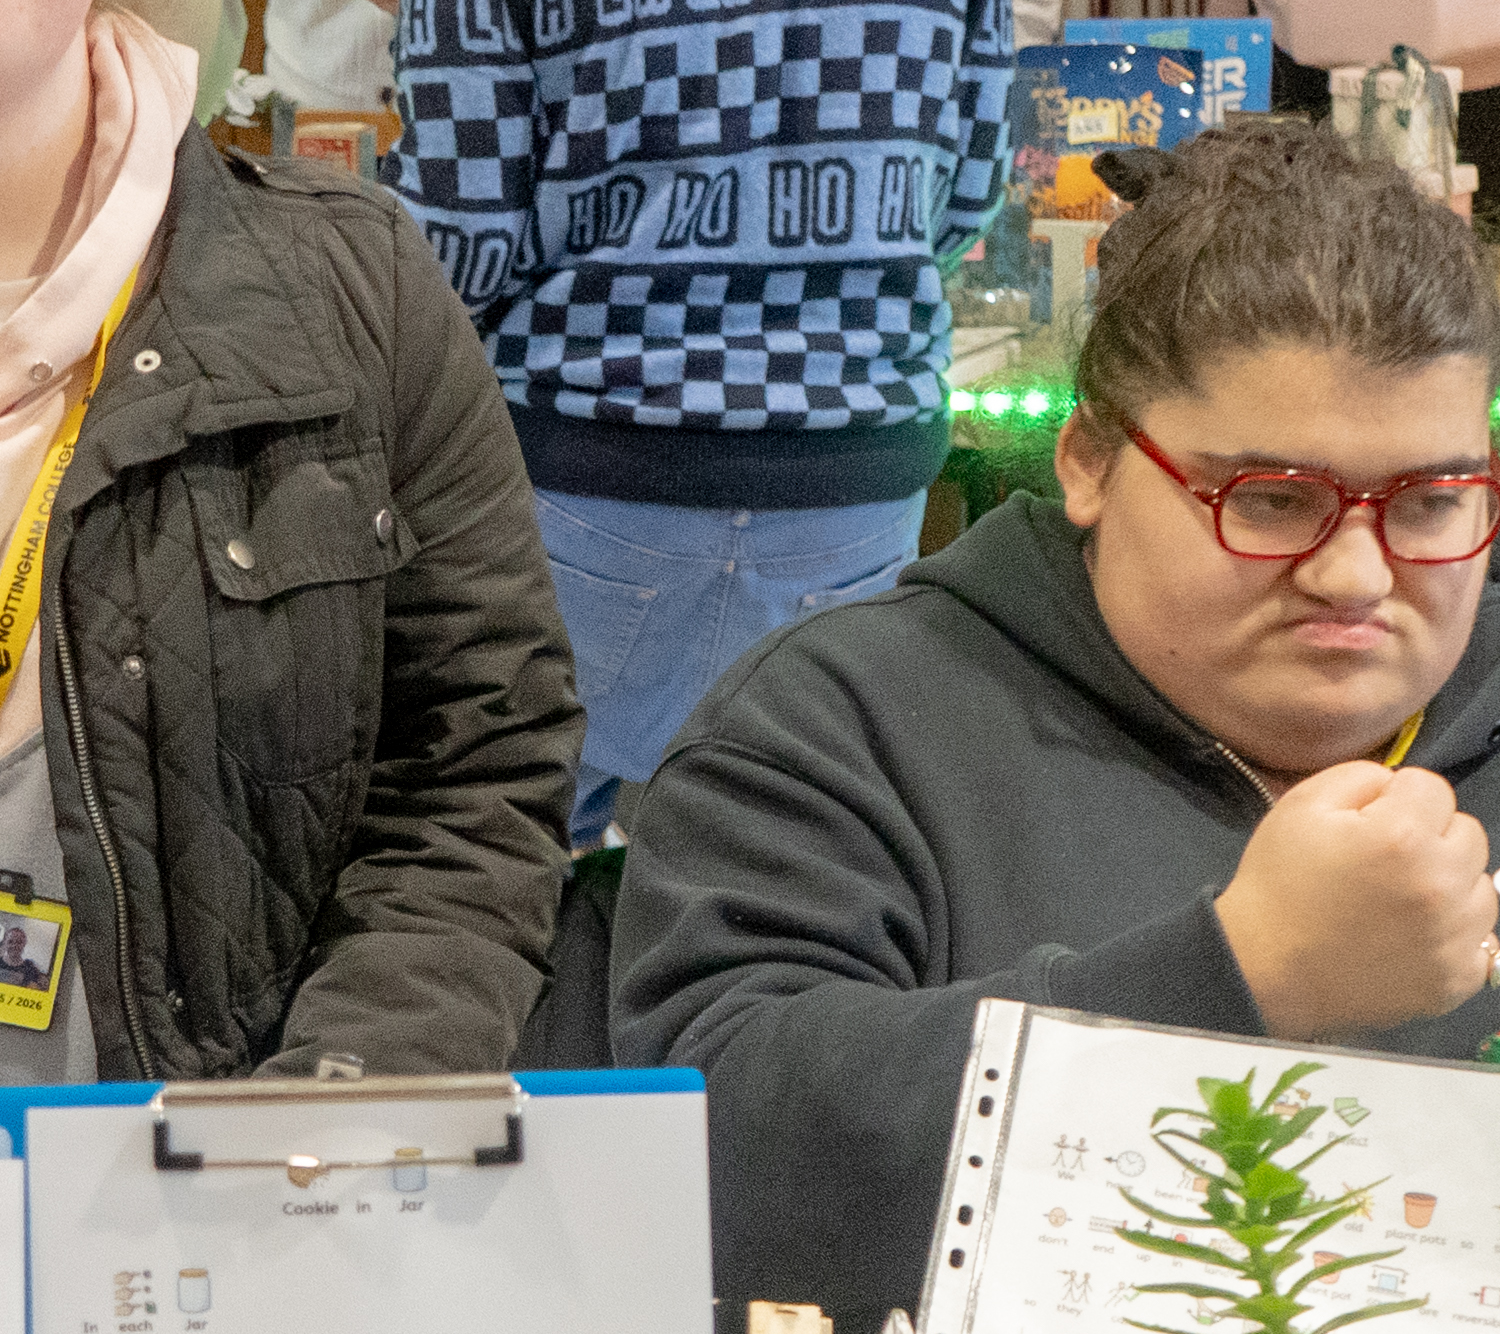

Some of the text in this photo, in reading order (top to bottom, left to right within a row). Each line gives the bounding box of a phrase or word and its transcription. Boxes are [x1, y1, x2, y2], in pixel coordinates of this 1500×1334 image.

[566, 174, 648, 255] HO
[658, 167, 740, 249] HO
[768, 160, 855, 247] HO
[37, 440, 76, 517] COLLEGE
[16, 996, 43, 1011] 2026
[282, 1198, 426, 1216] Cookie in Jar
[83, 1318, 208, 1334] In each Jar
